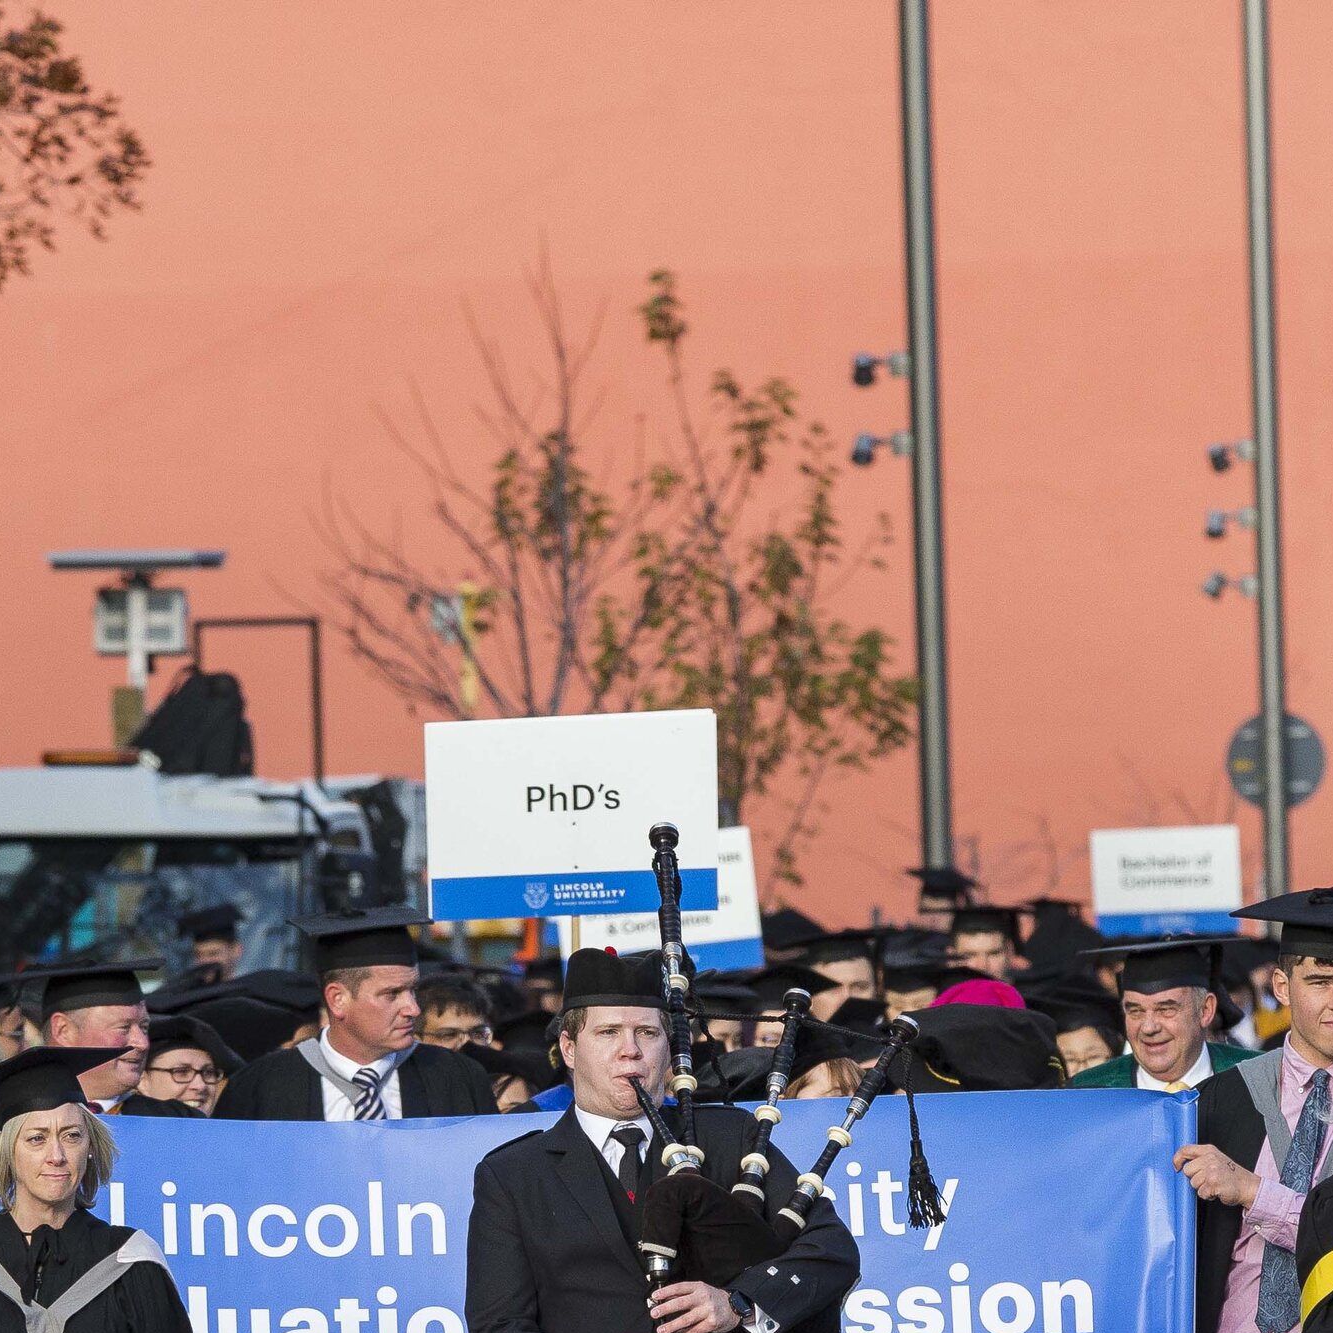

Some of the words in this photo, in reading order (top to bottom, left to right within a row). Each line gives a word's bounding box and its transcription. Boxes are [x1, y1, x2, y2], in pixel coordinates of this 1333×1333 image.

[526, 783, 621, 812] PhD's
[553, 882, 605, 892] LINCOLN
[553, 889, 626, 900] UNIVERSITY
